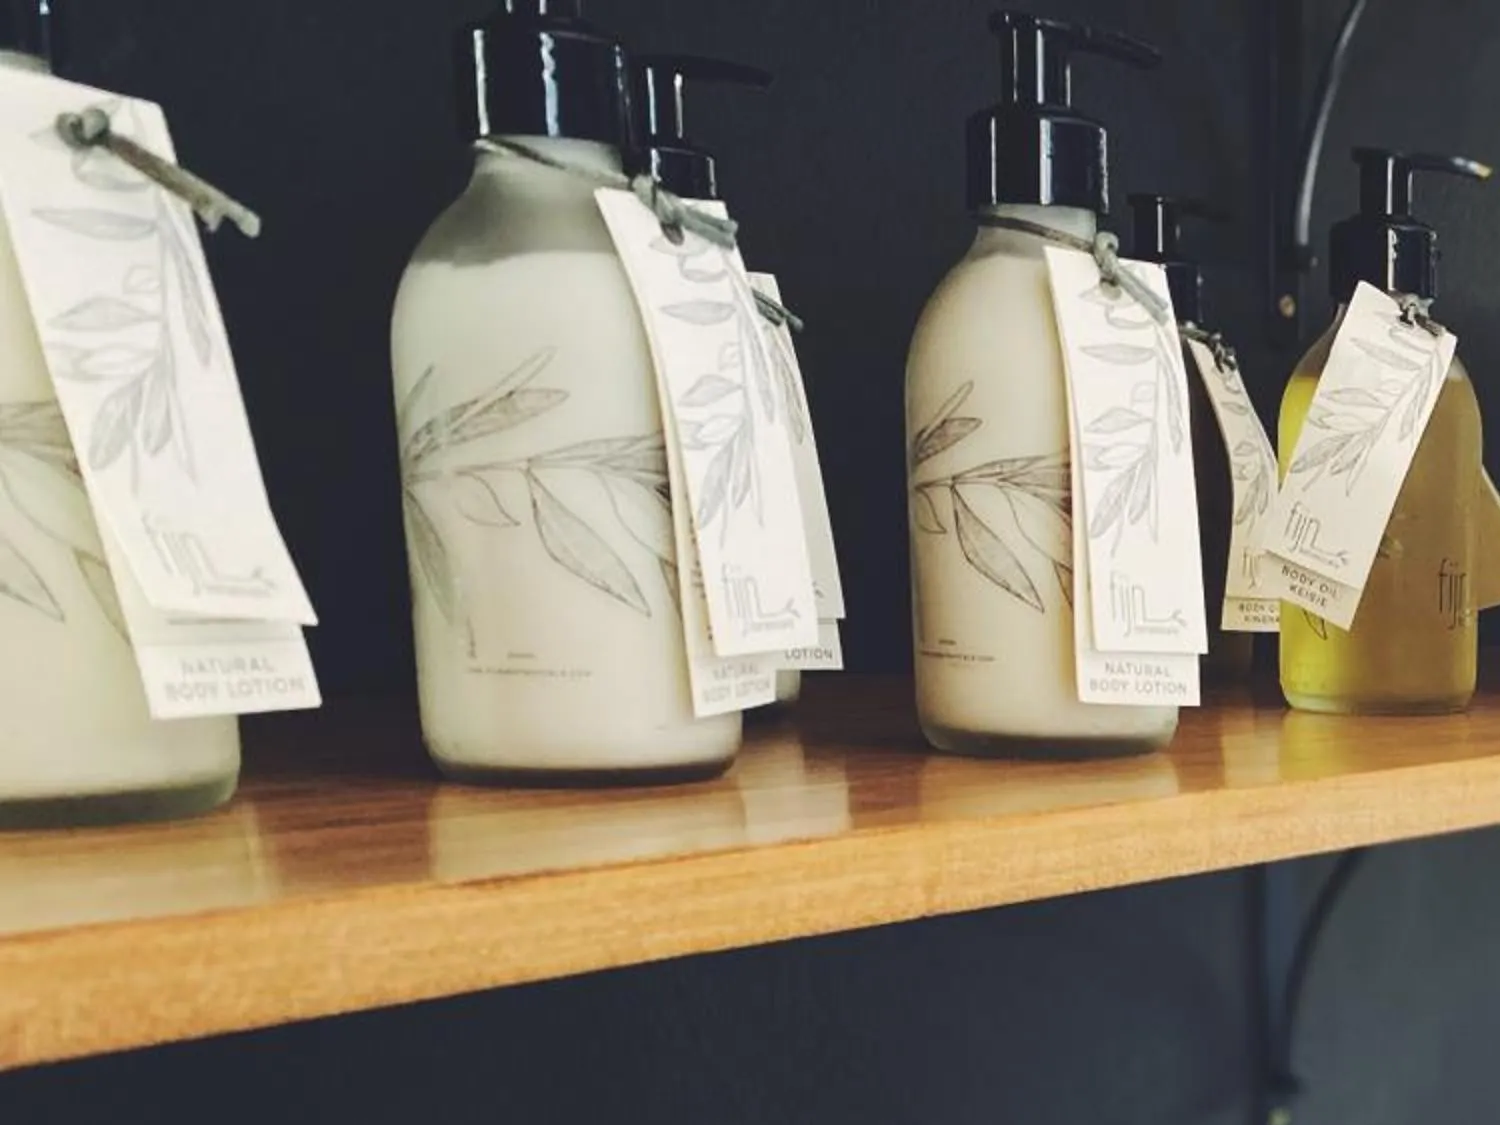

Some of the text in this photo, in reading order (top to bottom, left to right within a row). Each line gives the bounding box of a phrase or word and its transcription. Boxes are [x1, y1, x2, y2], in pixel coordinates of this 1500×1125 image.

[1281, 564, 1316, 587] BODY
[785, 647, 833, 660] LOTION
[181, 655, 276, 675] NATURAL
[1104, 660, 1170, 678] NATURAL
[164, 677, 305, 702] BODY LOTION
[1089, 678, 1187, 697] BODY LOTION
